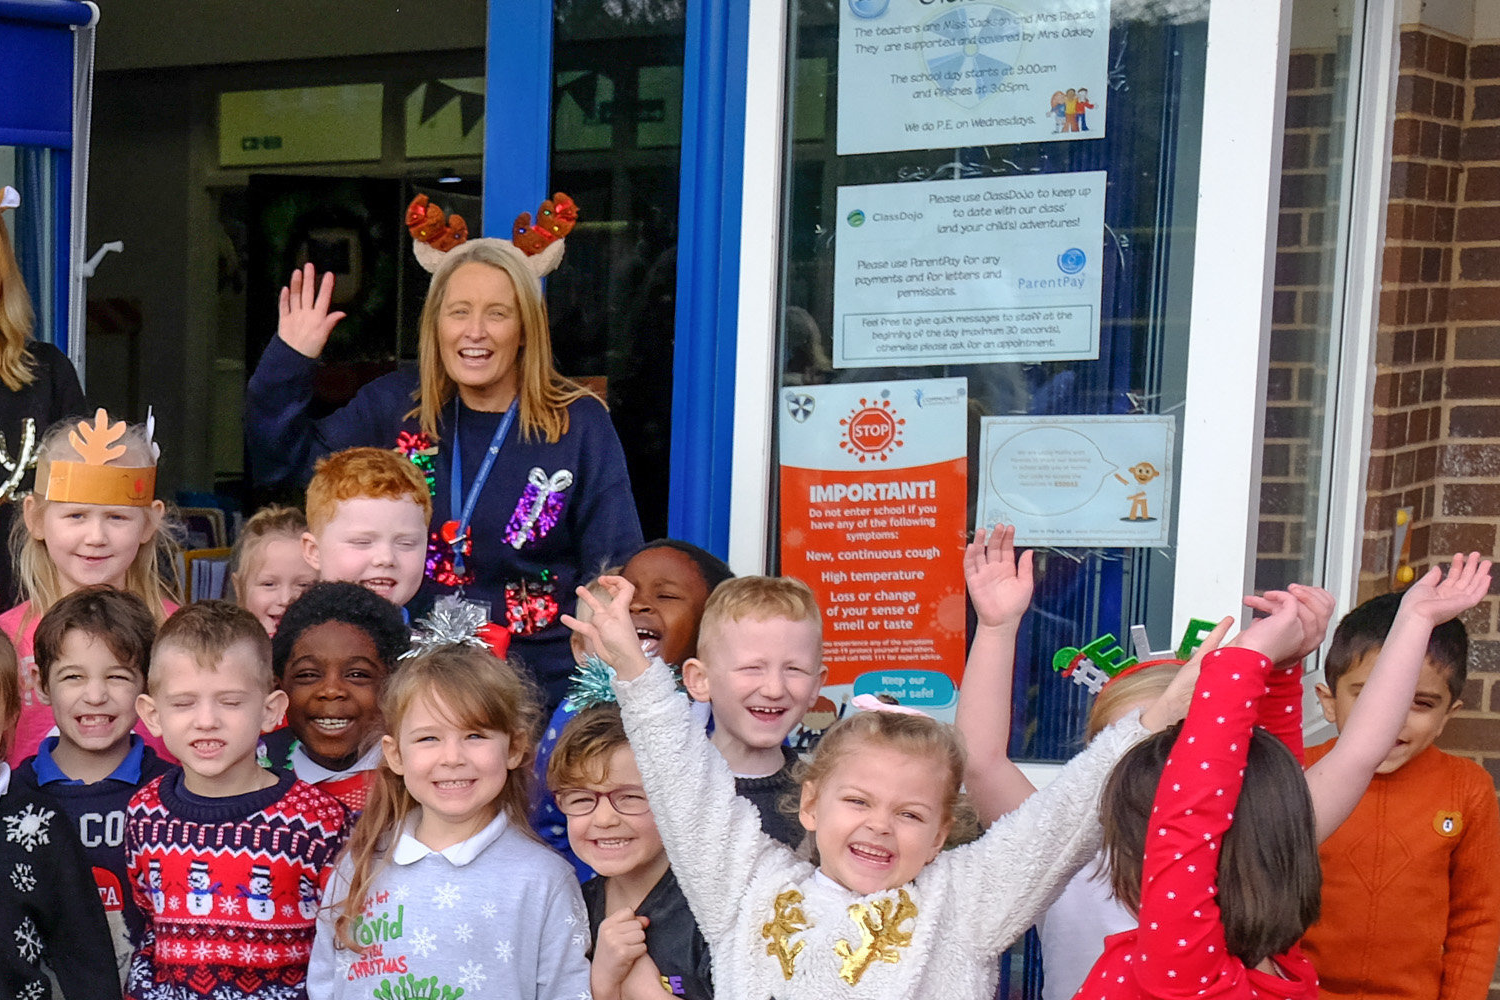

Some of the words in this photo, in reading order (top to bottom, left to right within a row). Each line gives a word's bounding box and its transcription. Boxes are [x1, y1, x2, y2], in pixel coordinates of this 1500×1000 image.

[854, 43, 879, 55] They
[884, 43, 902, 52] are
[904, 38, 956, 51] supported
[957, 36, 977, 46] and
[978, 33, 1020, 45] covered
[1022, 32, 1035, 42] by
[1037, 30, 1059, 40] Mrs
[890, 73, 909, 84] The
[910, 71, 942, 82] school
[944, 69, 962, 81] day
[965, 67, 999, 79] starts
[1001, 65, 1015, 76] at
[912, 88, 931, 99] and
[934, 85, 972, 97] finishes
[974, 83, 988, 94] at
[904, 121, 920, 132] We
[921, 120, 935, 131] do
[956, 118, 969, 129] on
[929, 193, 961, 204] Please
[963, 193, 981, 203] use
[1037, 188, 1050, 199] to
[1051, 187, 1076, 198] keep
[1078, 187, 1092, 198] up
[872, 211, 924, 222] ClassDojo
[953, 207, 964, 218] to
[967, 206, 992, 217] date
[994, 205, 1017, 215] with
[1018, 205, 1037, 215] our
[960, 224, 984, 235] your
[857, 259, 889, 270] Please
[891, 260, 908, 269] use
[963, 255, 980, 265] for
[982, 256, 1001, 266] any
[854, 274, 903, 287] payments
[905, 273, 924, 283] and
[926, 271, 944, 282] for
[945, 270, 981, 281] letters
[982, 269, 1002, 280] and
[1018, 276, 1086, 290] ParentPay
[854, 424, 890, 438] STOP
[809, 480, 936, 503] IMPORTANT!
[808, 507, 823, 518] Do
[824, 506, 842, 518] not
[843, 506, 871, 517] enter
[874, 504, 905, 516] school
[908, 504, 917, 514] if
[918, 504, 937, 516] you
[810, 520, 835, 531] have
[837, 520, 855, 531] any
[857, 518, 868, 529] of
[870, 518, 888, 528] the
[890, 516, 936, 528] following
[846, 530, 899, 543] symptoms:
[806, 549, 834, 562] New,
[837, 548, 903, 561] continuous
[905, 545, 941, 560] cough
[821, 570, 848, 585] High
[850, 569, 925, 584] temperature
[830, 590, 856, 602] Loss
[858, 591, 872, 602] or
[874, 589, 917, 603] change
[826, 604, 840, 617] of
[841, 605, 869, 619] your
[871, 605, 905, 616] sense
[907, 602, 921, 615] of
[833, 618, 864, 631] smell
[867, 619, 881, 631] or
[883, 618, 914, 630] taste
[79, 810, 126, 848] CO
